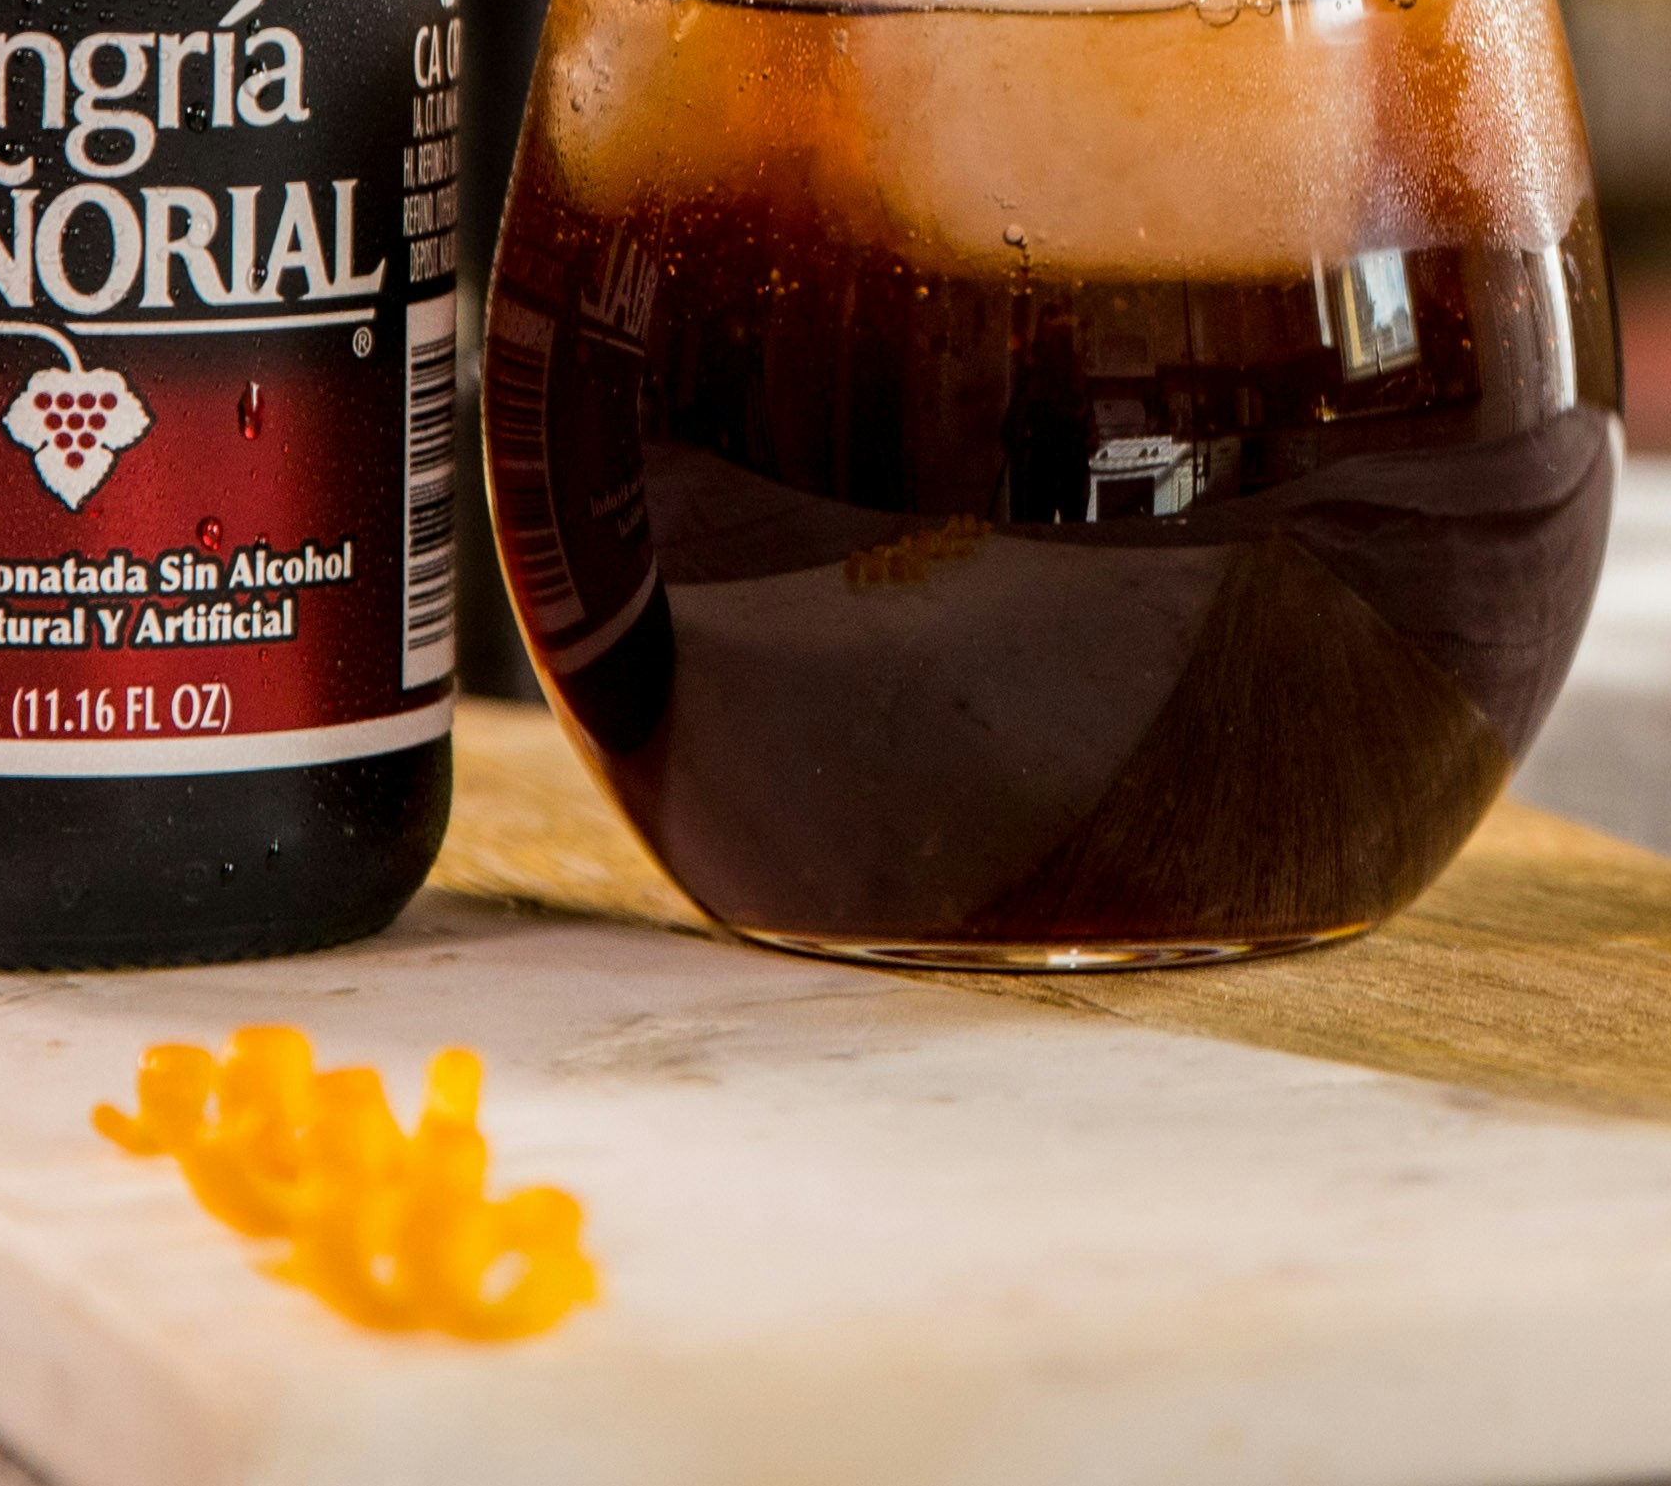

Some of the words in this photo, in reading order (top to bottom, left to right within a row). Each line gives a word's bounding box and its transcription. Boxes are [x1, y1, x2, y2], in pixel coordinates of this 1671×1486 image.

[414, 25, 441, 89] CA
[159, 553, 219, 593] Sin
[228, 540, 353, 589] Alcohol
[97, 609, 125, 645] Y
[133, 598, 294, 644] Artificial
[12, 686, 117, 738] (11.16
[126, 685, 162, 731] FL
[171, 682, 233, 734] OZ)
